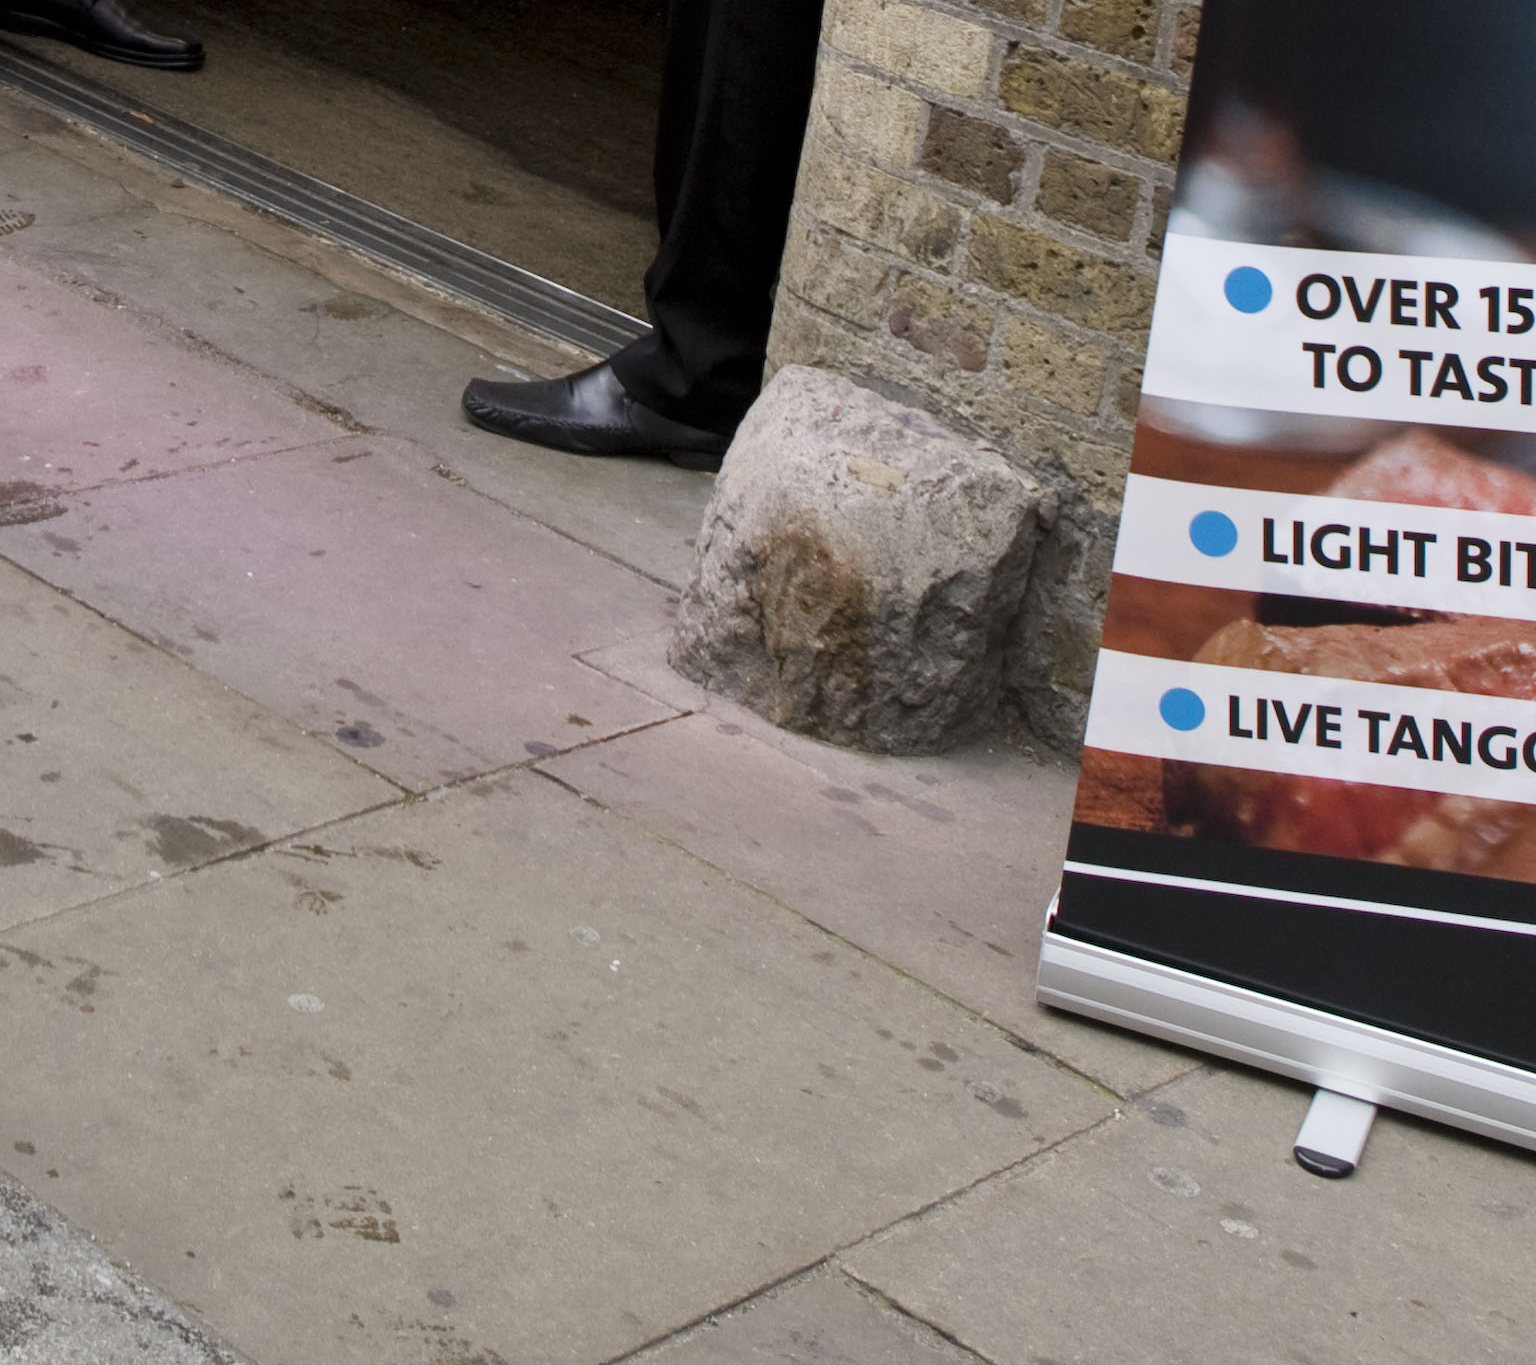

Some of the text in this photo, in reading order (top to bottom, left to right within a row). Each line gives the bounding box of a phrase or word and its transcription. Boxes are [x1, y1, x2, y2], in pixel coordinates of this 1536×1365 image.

[1295, 272, 1462, 332] OVER
[1302, 342, 1383, 393] TO
[1261, 516, 1437, 578] LIGHT
[1228, 694, 1343, 750] LIVE
